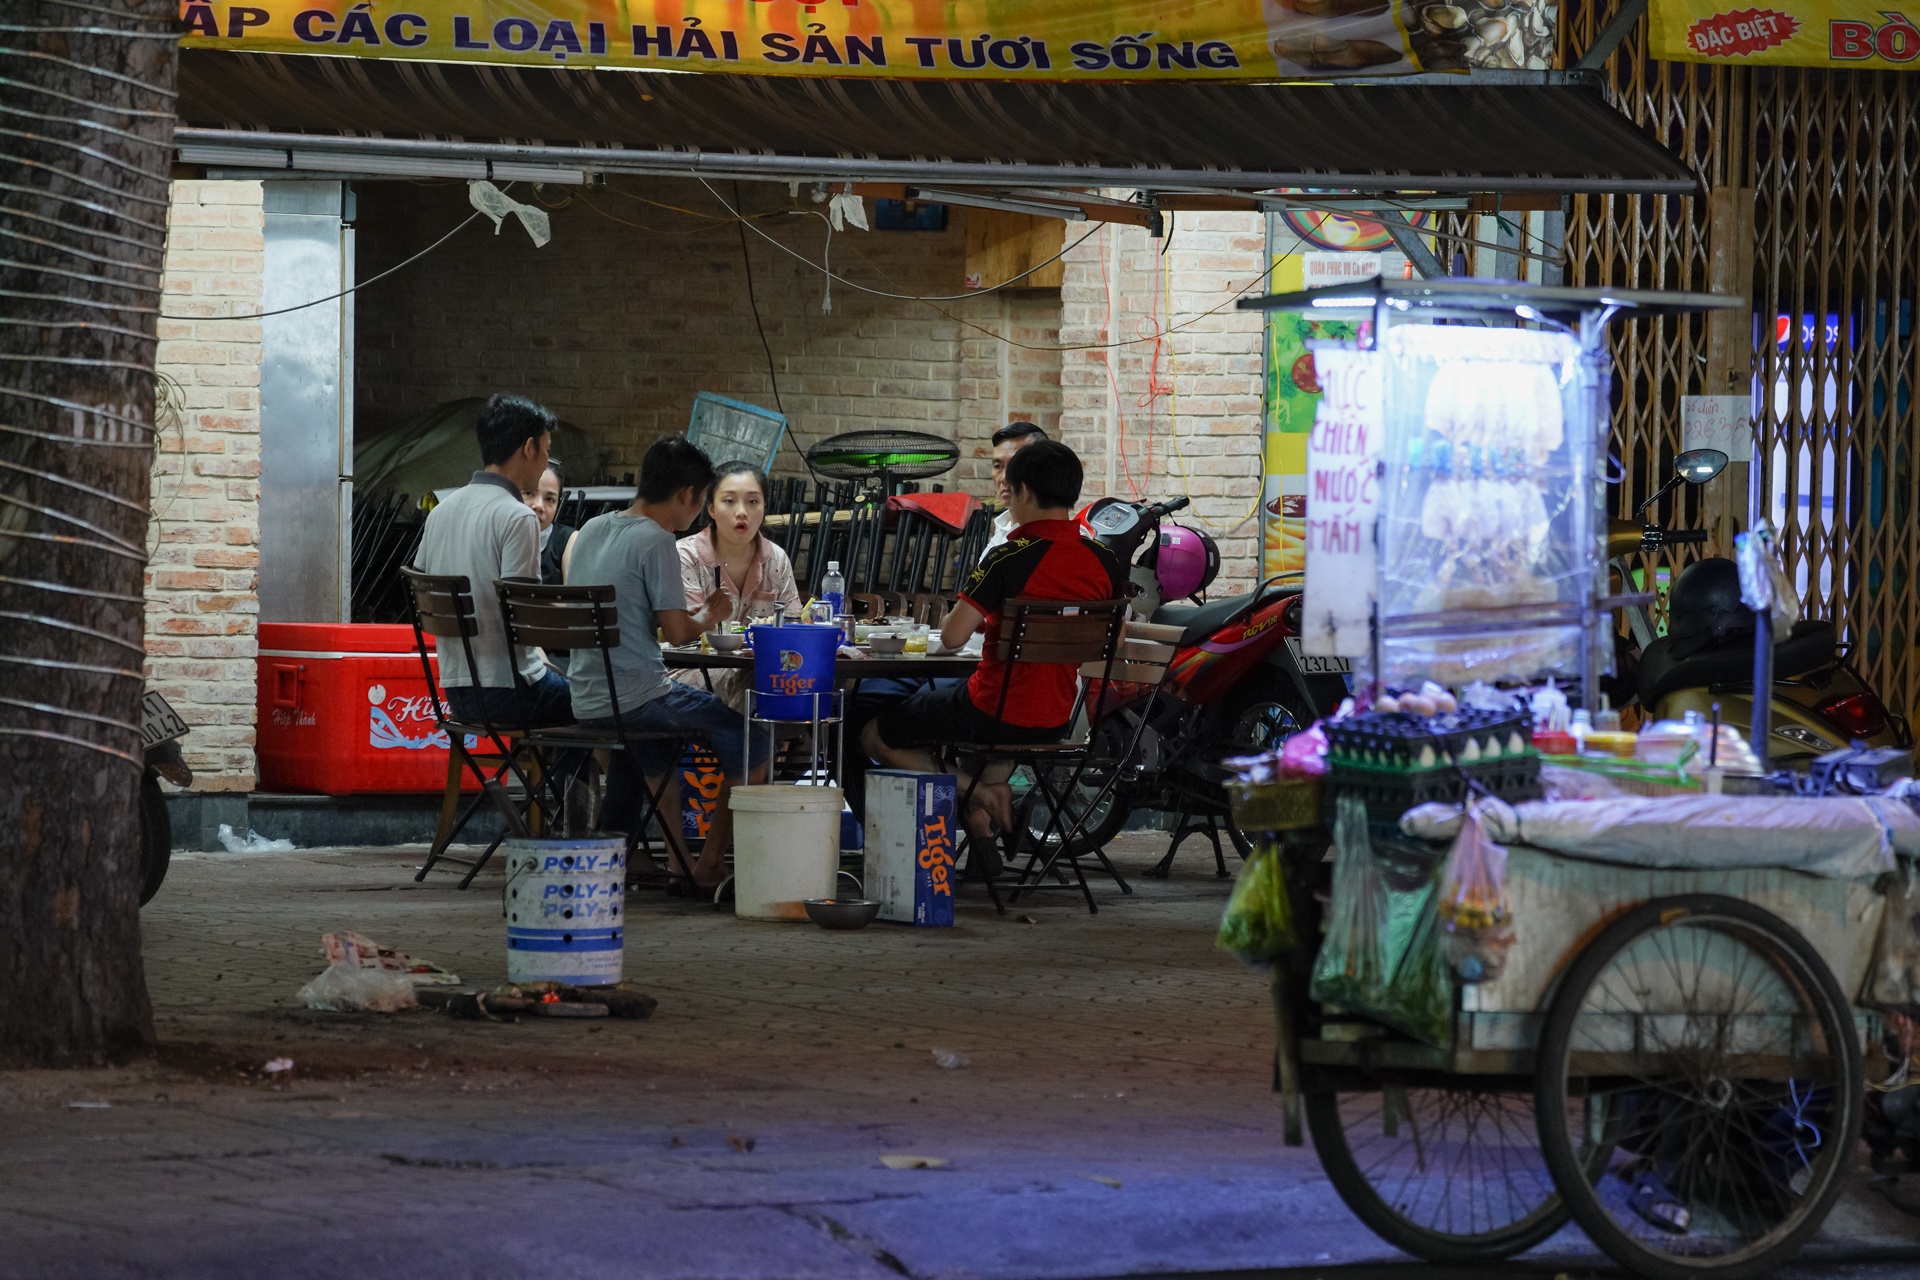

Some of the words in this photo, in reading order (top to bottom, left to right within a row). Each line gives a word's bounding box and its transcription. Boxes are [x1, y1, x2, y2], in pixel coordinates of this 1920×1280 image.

[293, 4, 428, 46] CÁC
[454, 16, 606, 59] LOẠI
[632, 17, 739, 60] HẢI
[762, 22, 886, 65] SẢN
[906, 34, 1051, 70] TƯƠI
[1070, 32, 1241, 70] SỐNG
[1695, 26, 1735, 52] ĐẶC
[1738, 14, 1780, 41] BIỆT
[1829, 10, 1920, 62] BÒ
[769, 673, 816, 696] Tiger
[919, 816, 954, 896] Tiger
